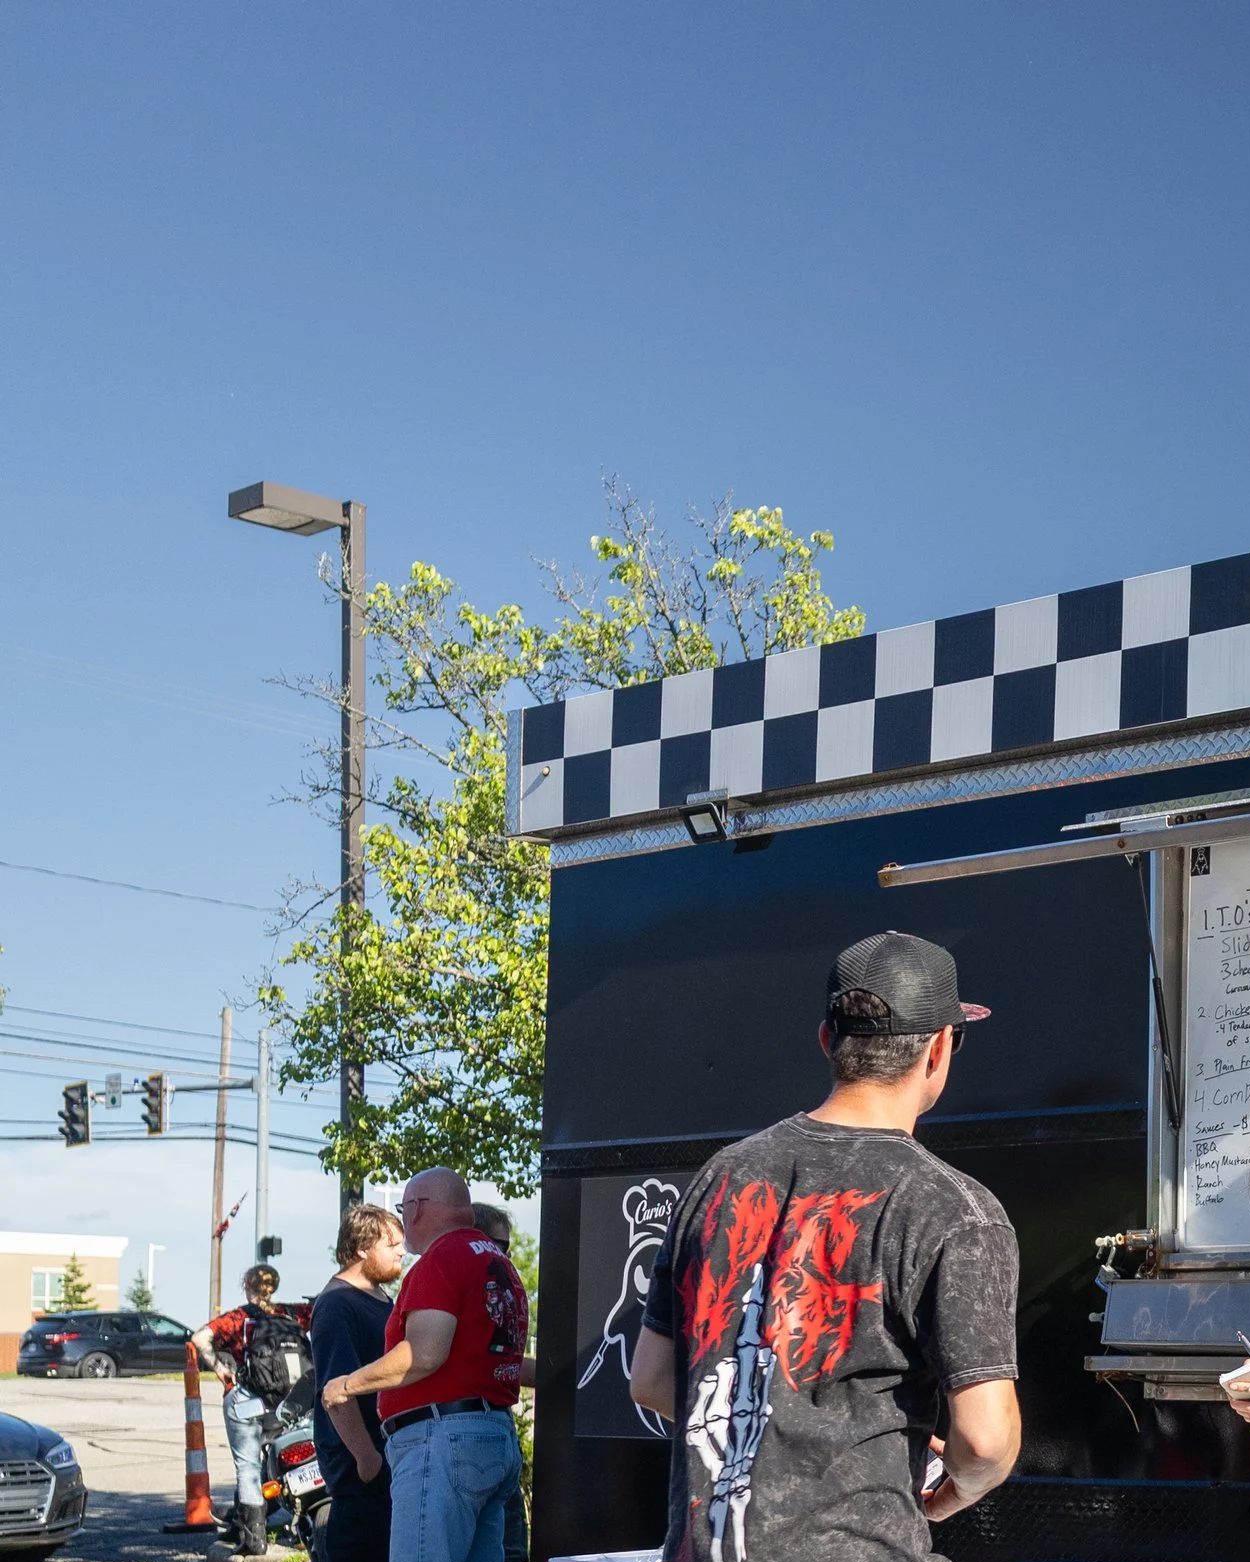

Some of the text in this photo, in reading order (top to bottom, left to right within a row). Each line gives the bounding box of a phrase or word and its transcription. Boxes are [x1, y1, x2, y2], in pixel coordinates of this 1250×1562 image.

[1226, 1035, 1238, 1047] of
[1213, 1057, 1235, 1073] Plain
[1195, 1120, 1225, 1135] Sauces
[1195, 1140, 1219, 1157] BBQ
[1194, 1158, 1220, 1173] Honey
[1196, 1174, 1224, 1191] Ranch
[1195, 1193, 1225, 1207] Buffalo
[634, 1198, 673, 1225] Cario's
[468, 1239, 509, 1260] DUCA
